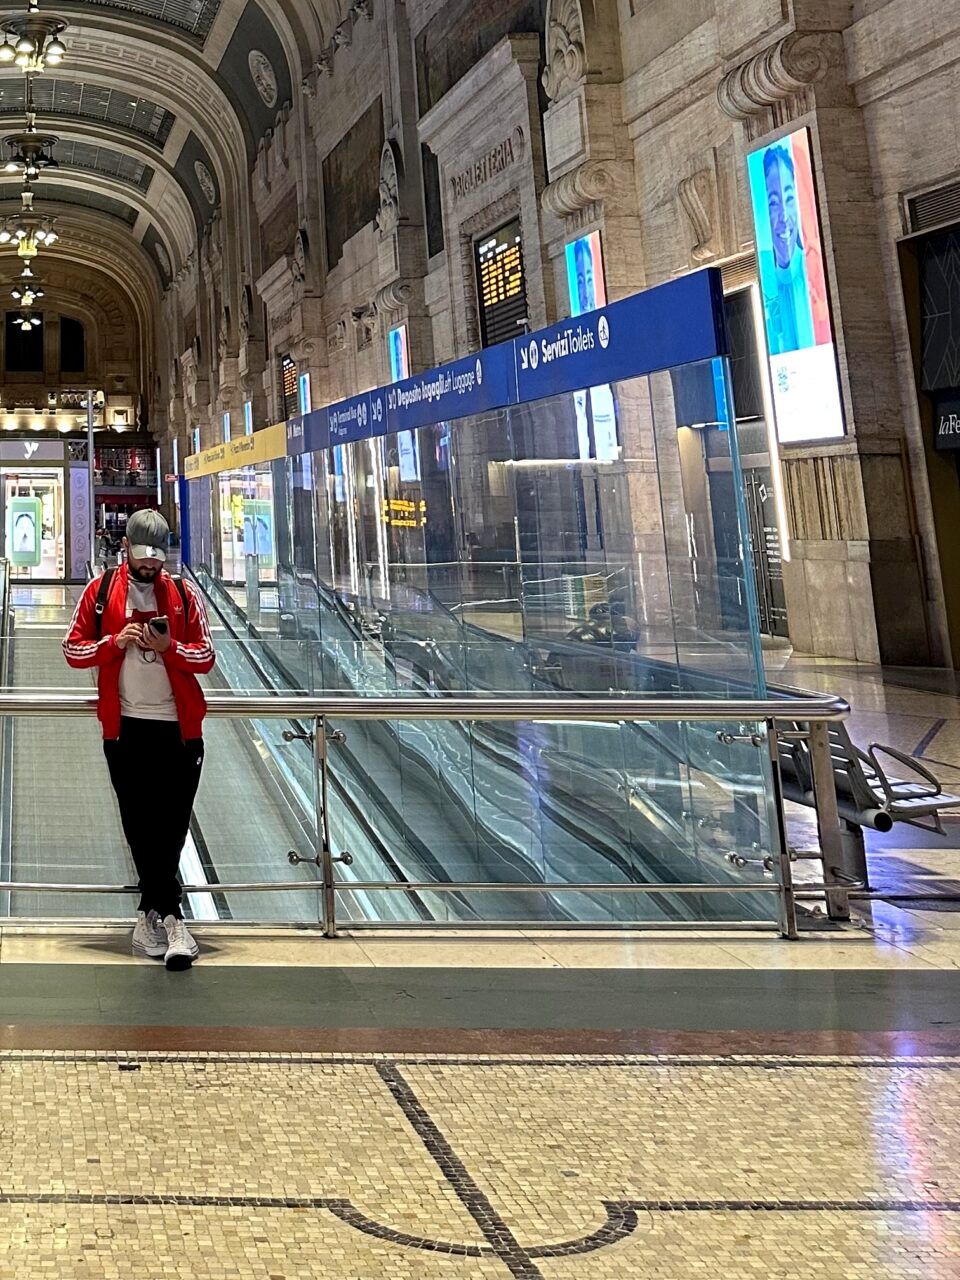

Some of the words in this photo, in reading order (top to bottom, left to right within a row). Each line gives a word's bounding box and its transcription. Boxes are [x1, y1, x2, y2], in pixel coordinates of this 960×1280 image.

[456, 138, 514, 198] BIGLIETTERIA
[397, 384, 422, 410] Deposito
[451, 370, 475, 395] Luggage
